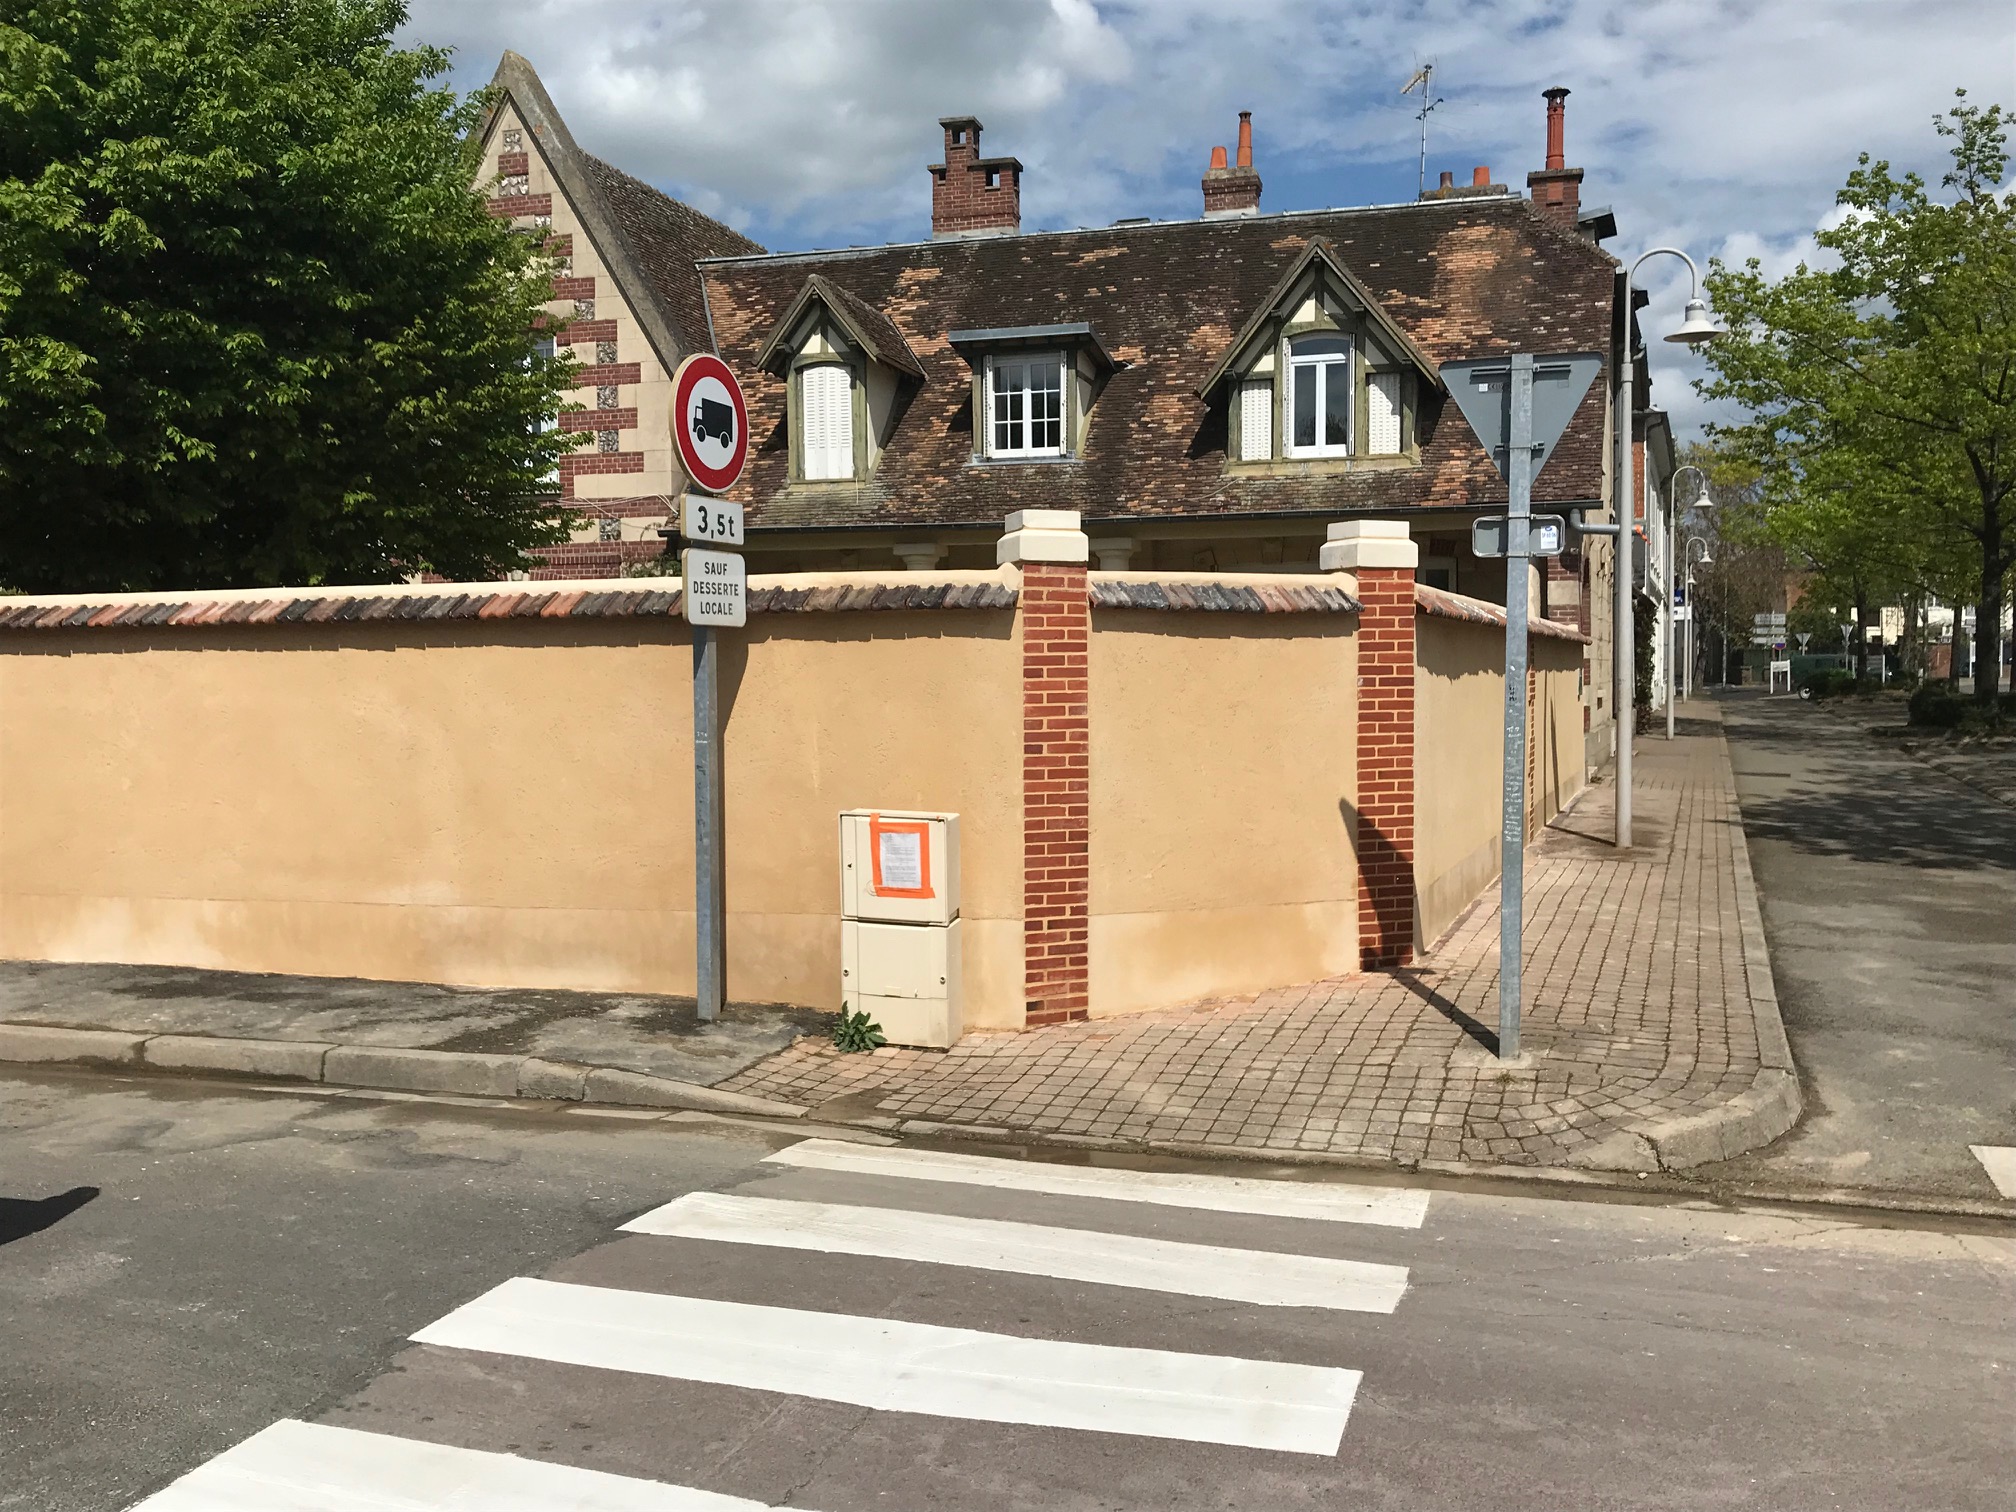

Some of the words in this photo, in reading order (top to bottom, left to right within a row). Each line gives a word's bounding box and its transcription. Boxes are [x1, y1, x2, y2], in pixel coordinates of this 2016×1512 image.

[698, 505, 735, 539] 3,5t
[704, 561, 728, 576] SAUF
[693, 581, 739, 596] DESSERTE
[700, 602, 733, 616] LOCALE
